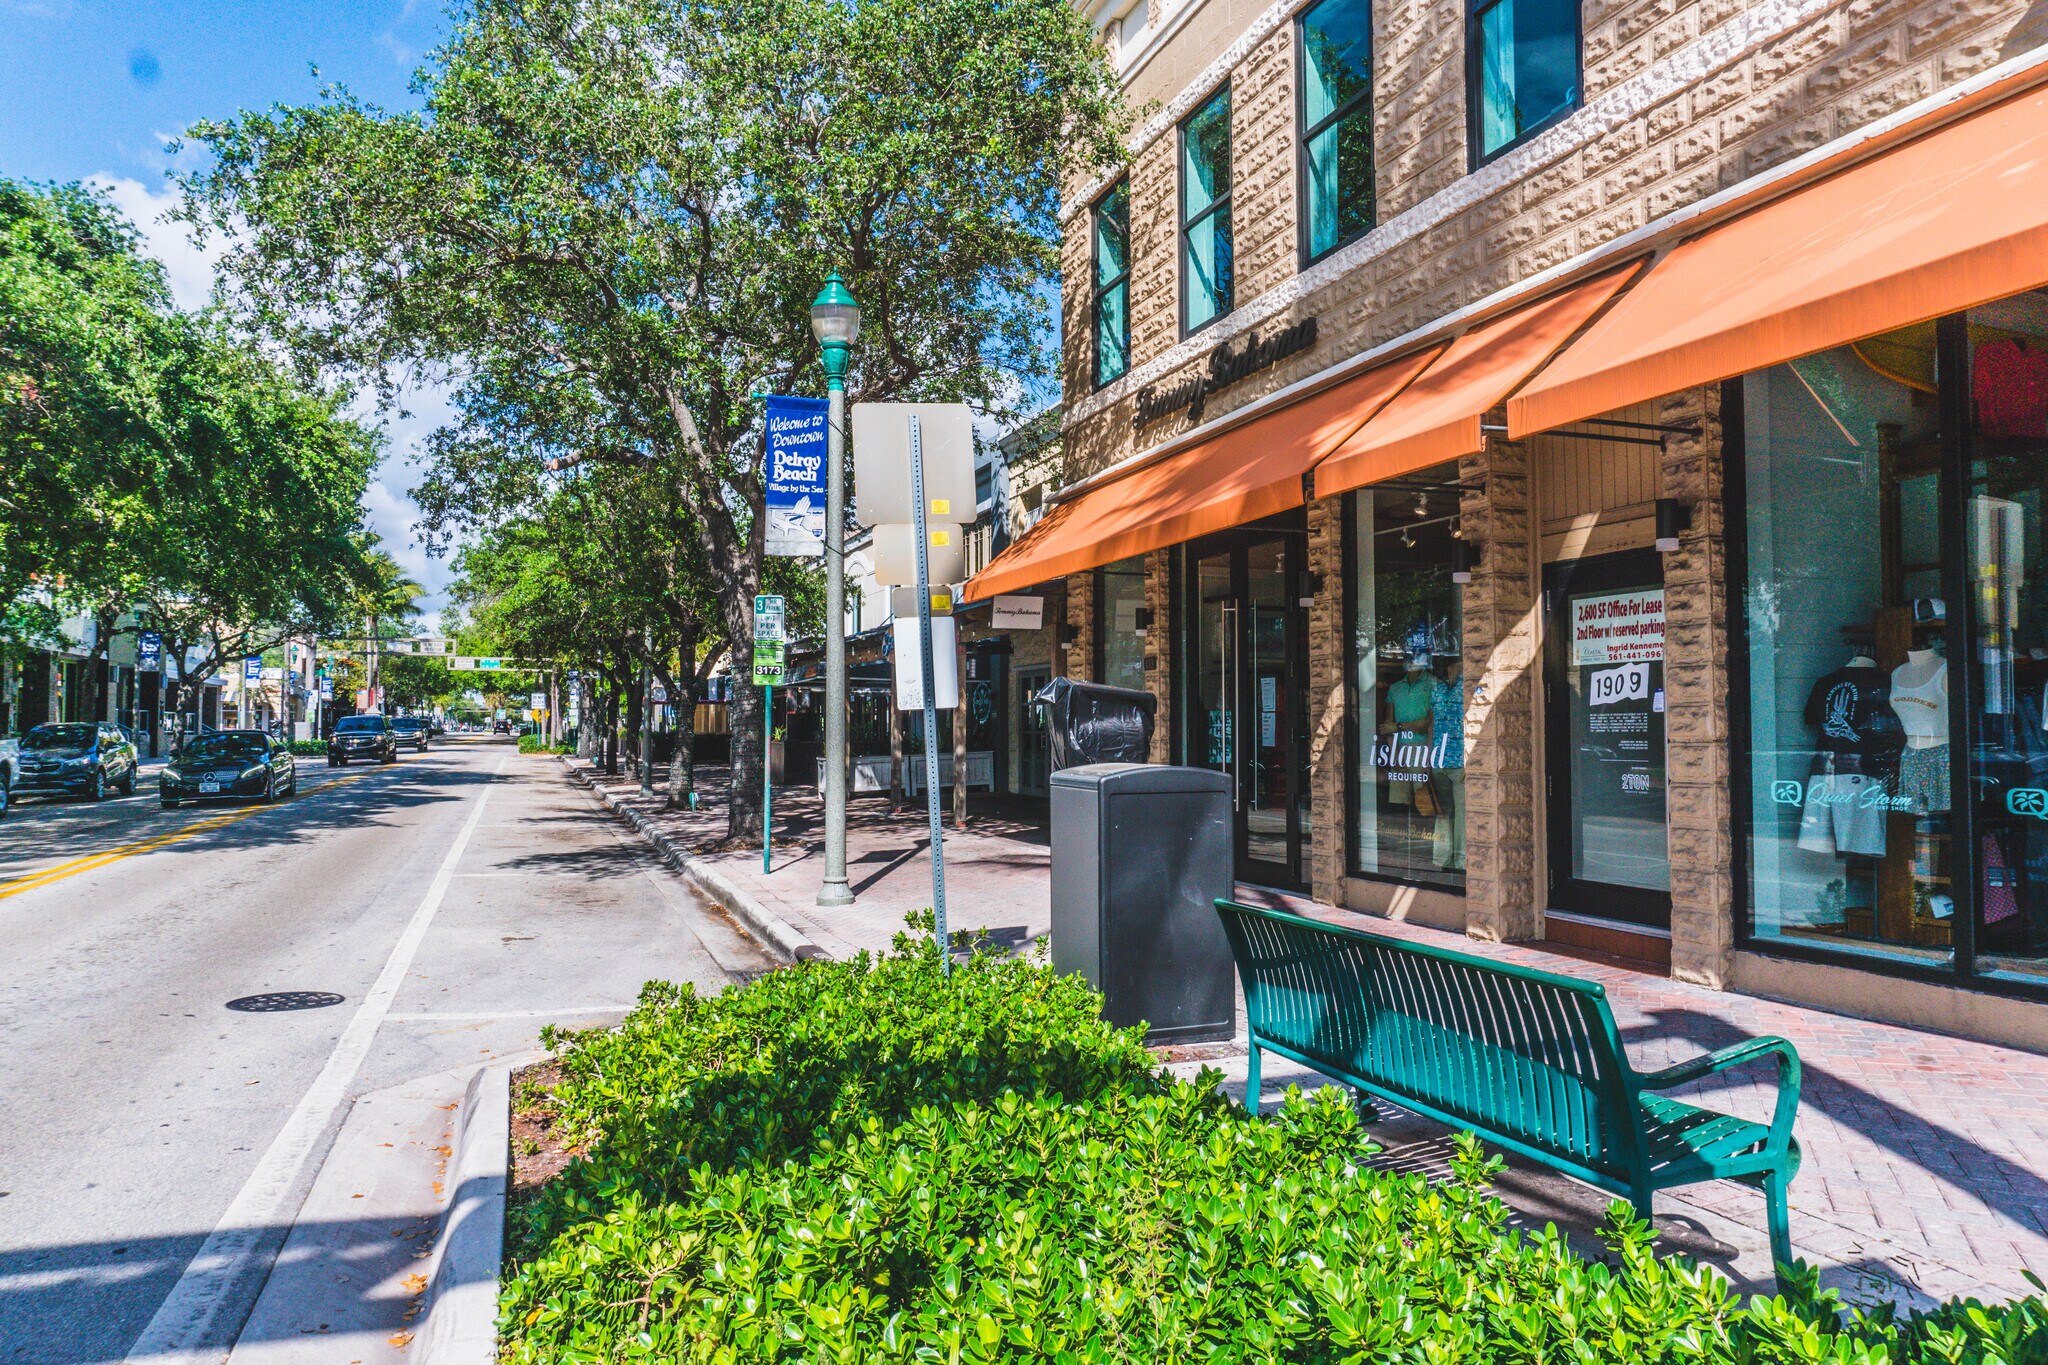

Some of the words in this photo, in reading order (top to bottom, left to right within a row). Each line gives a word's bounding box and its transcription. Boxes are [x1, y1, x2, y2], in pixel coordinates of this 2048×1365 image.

[770, 416, 810, 432] Welcome
[812, 415, 824, 427] to
[772, 430, 824, 448] Downtown
[774, 450, 822, 470] Delray
[773, 466, 817, 482] Beach
[769, 482, 790, 493] Village
[790, 484, 799, 494] by
[800, 484, 810, 493] the
[811, 486, 824, 494] Sea
[757, 600, 764, 610] 3
[994, 607, 1016, 616] Tommy
[1016, 608, 1041, 616] Bahama
[1578, 604, 1598, 622] 2,600
[1598, 602, 1606, 618] SF
[1607, 600, 1628, 618] Office
[1628, 599, 1640, 616] For
[1642, 597, 1662, 614] Lease
[1576, 625, 1588, 640] 2nd
[1588, 624, 1604, 640] Floor
[1604, 623, 1612, 638] w/
[1612, 620, 1638, 638] reserved
[1640, 618, 1666, 639] parking
[1607, 643, 1628, 654] Ingrid
[1630, 642, 1664, 650] Kenneme
[756, 666, 781, 674] 3173
[1596, 672, 1642, 698] 1909
[1894, 696, 1938, 710] GODDESS
[1401, 730, 1414, 740] NO
[1369, 732, 1448, 768] island
[1388, 772, 1428, 782] REQUIRED
[1806, 782, 1856, 807] Quiet
[1858, 785, 1912, 808] Storm
